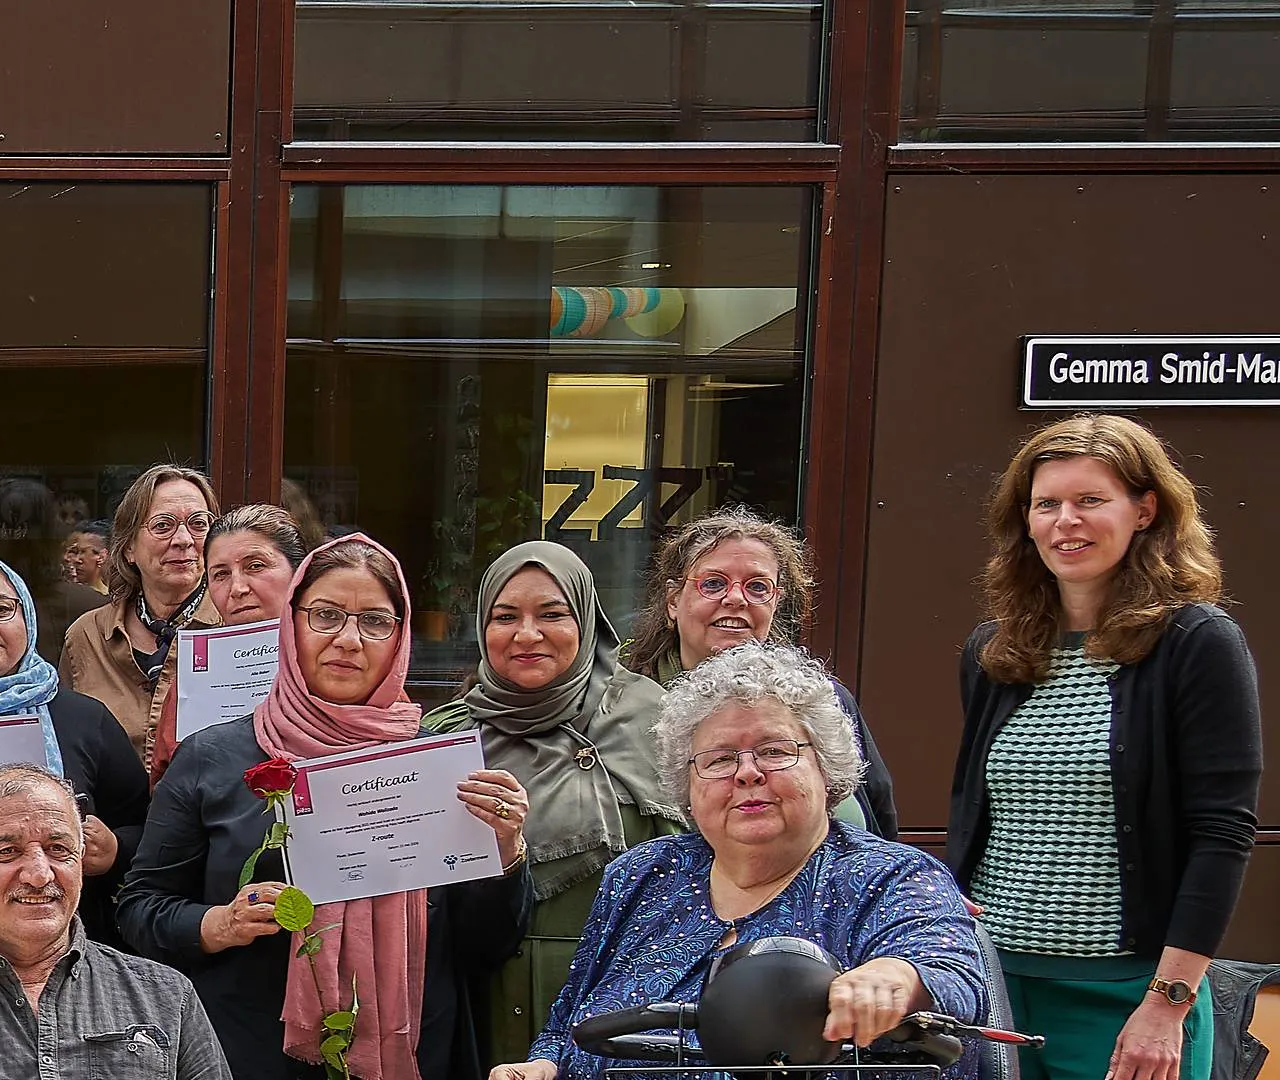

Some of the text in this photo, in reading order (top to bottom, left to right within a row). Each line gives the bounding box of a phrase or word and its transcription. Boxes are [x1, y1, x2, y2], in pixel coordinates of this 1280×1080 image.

[1049, 351, 1280, 384] Gemma Smid-Ma
[233, 644, 279, 658] Certifica
[341, 771, 419, 795] Certificaat
